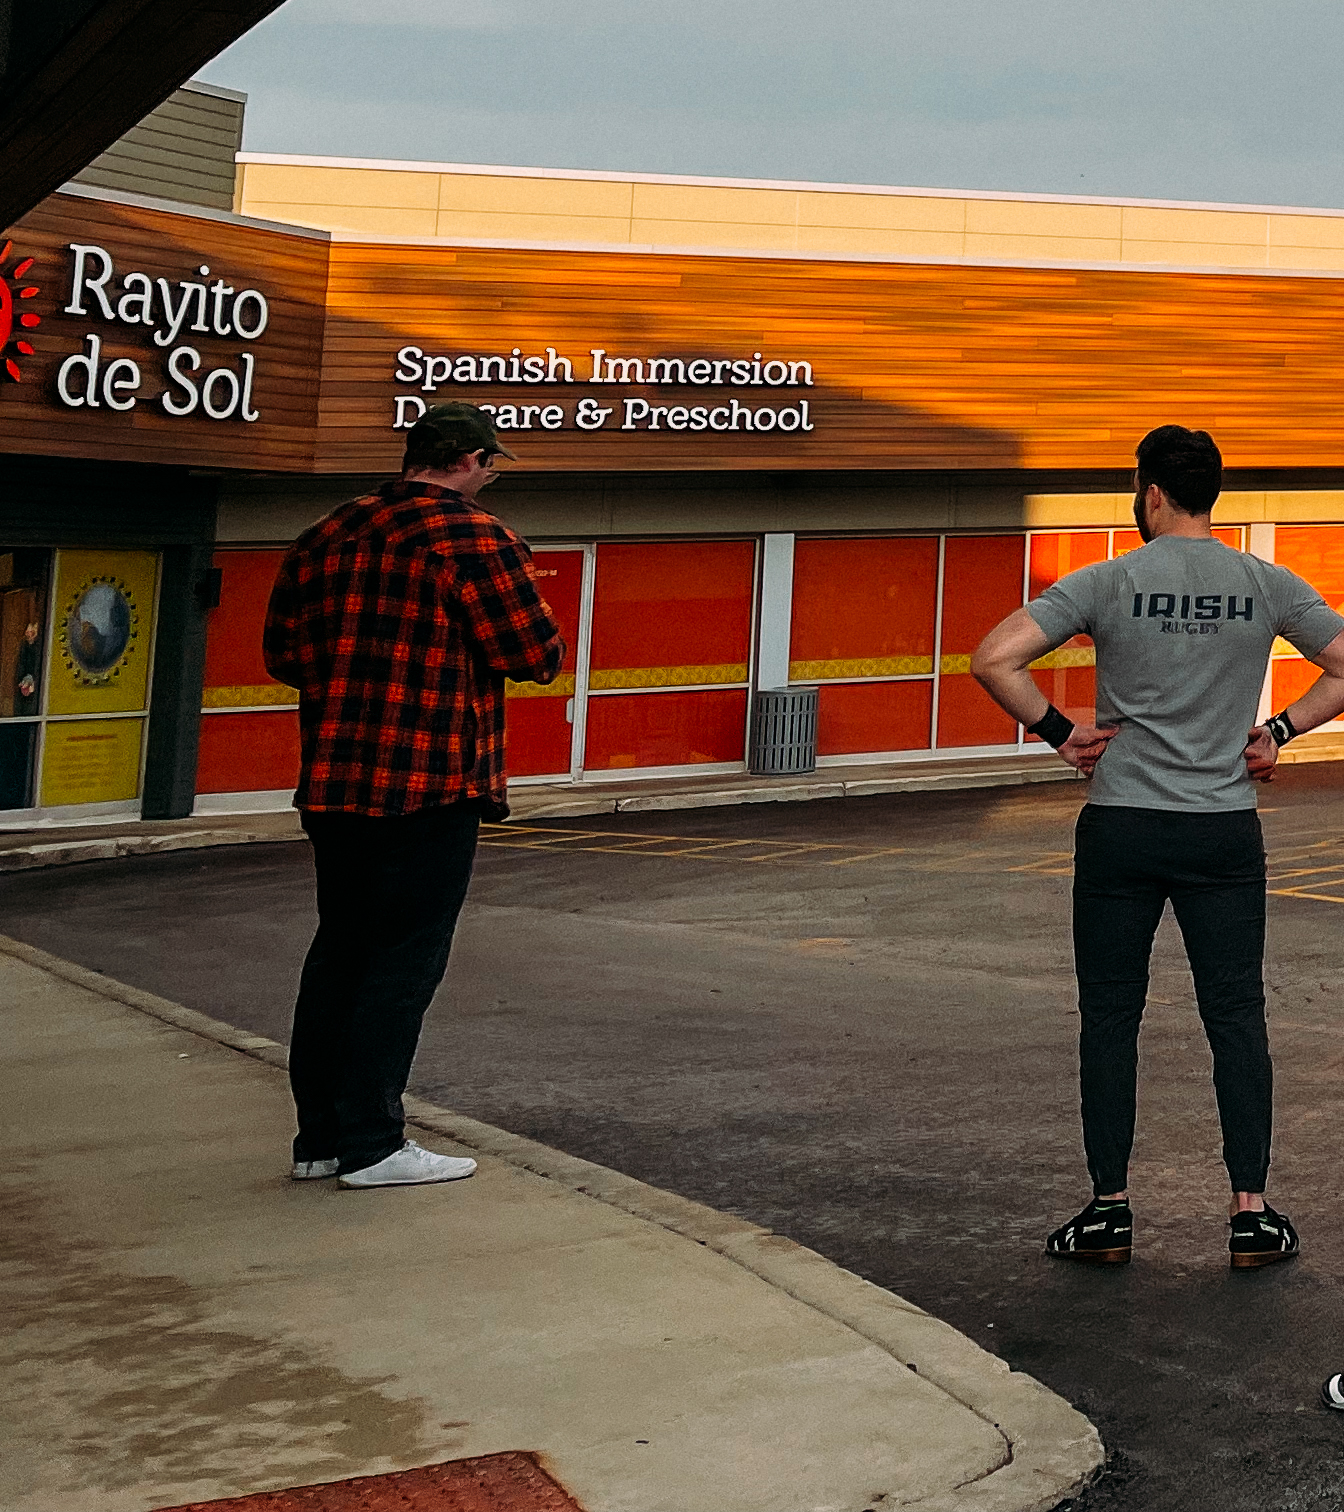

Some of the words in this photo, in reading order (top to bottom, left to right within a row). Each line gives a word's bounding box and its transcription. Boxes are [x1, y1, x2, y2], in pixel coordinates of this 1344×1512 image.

[64, 243, 269, 346] Rayito
[57, 333, 141, 411] de
[162, 346, 260, 422] Sol
[395, 345, 574, 391] Spanish
[588, 348, 814, 386] Immersion
[575, 397, 613, 430] &
[621, 397, 814, 432] Preschool
[1131, 592, 1254, 621] IRISH
[1159, 620, 1223, 635] RUGBY
